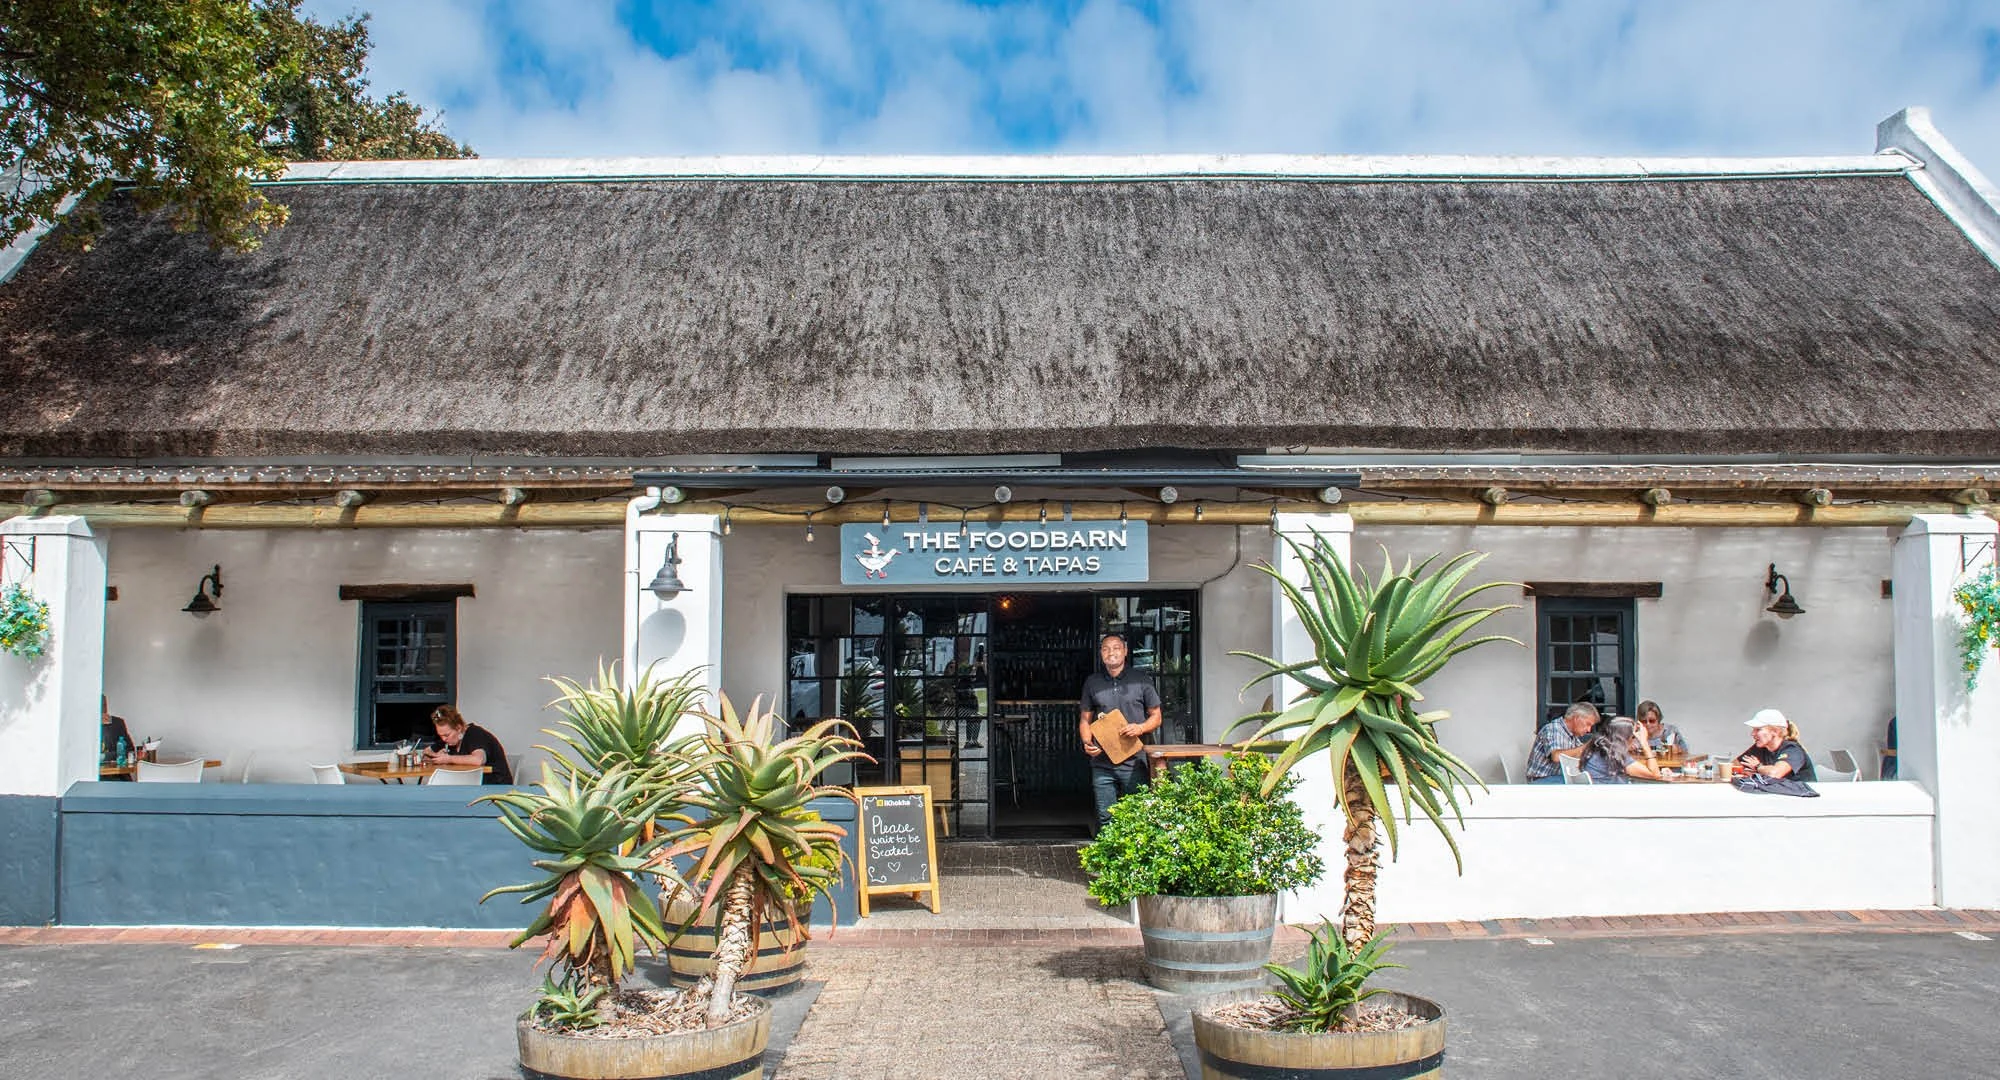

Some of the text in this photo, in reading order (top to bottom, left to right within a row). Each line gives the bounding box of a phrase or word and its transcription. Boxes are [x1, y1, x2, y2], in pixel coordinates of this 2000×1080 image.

[903, 530, 1128, 551] THE FOODBARN
[935, 554, 1101, 574] CAFÉ & TAPAS
[872, 815, 914, 834] Please
[869, 834, 921, 845] wait to be
[870, 845, 913, 859] Seated
